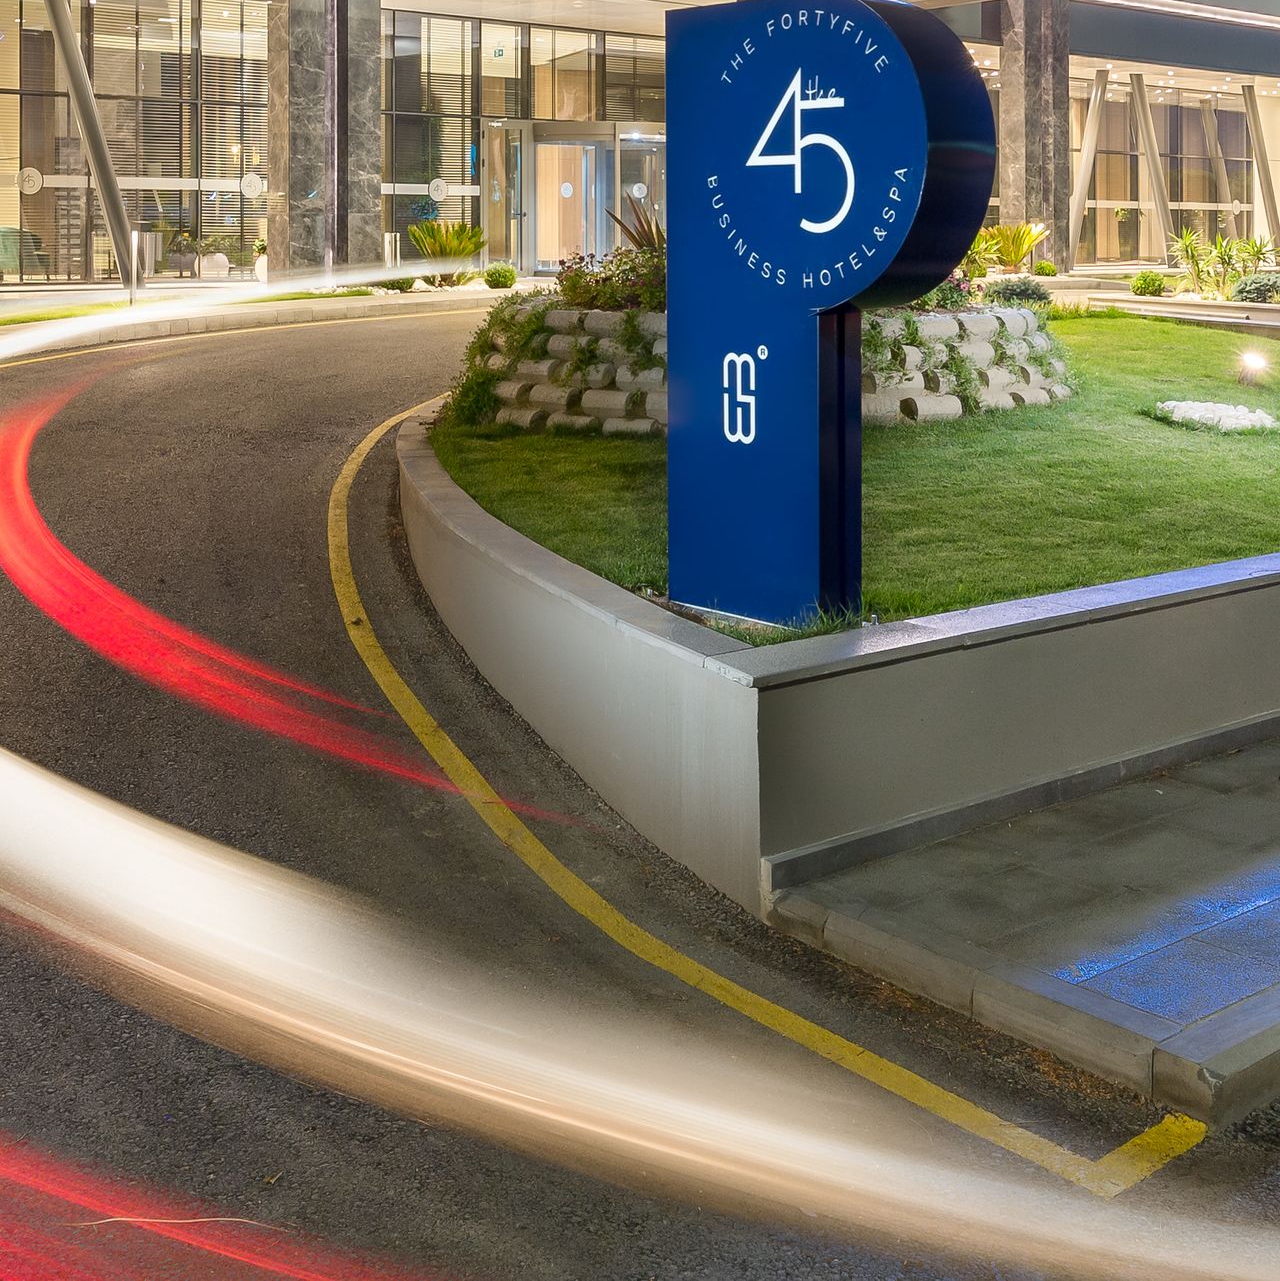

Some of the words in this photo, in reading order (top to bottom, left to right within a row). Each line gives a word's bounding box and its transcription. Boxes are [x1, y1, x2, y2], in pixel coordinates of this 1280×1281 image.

[720, 38, 755, 84] THE
[766, 10, 889, 73] FORTYFIVE
[745, 67, 855, 234] 45
[707, 175, 786, 285] BUSINESS
